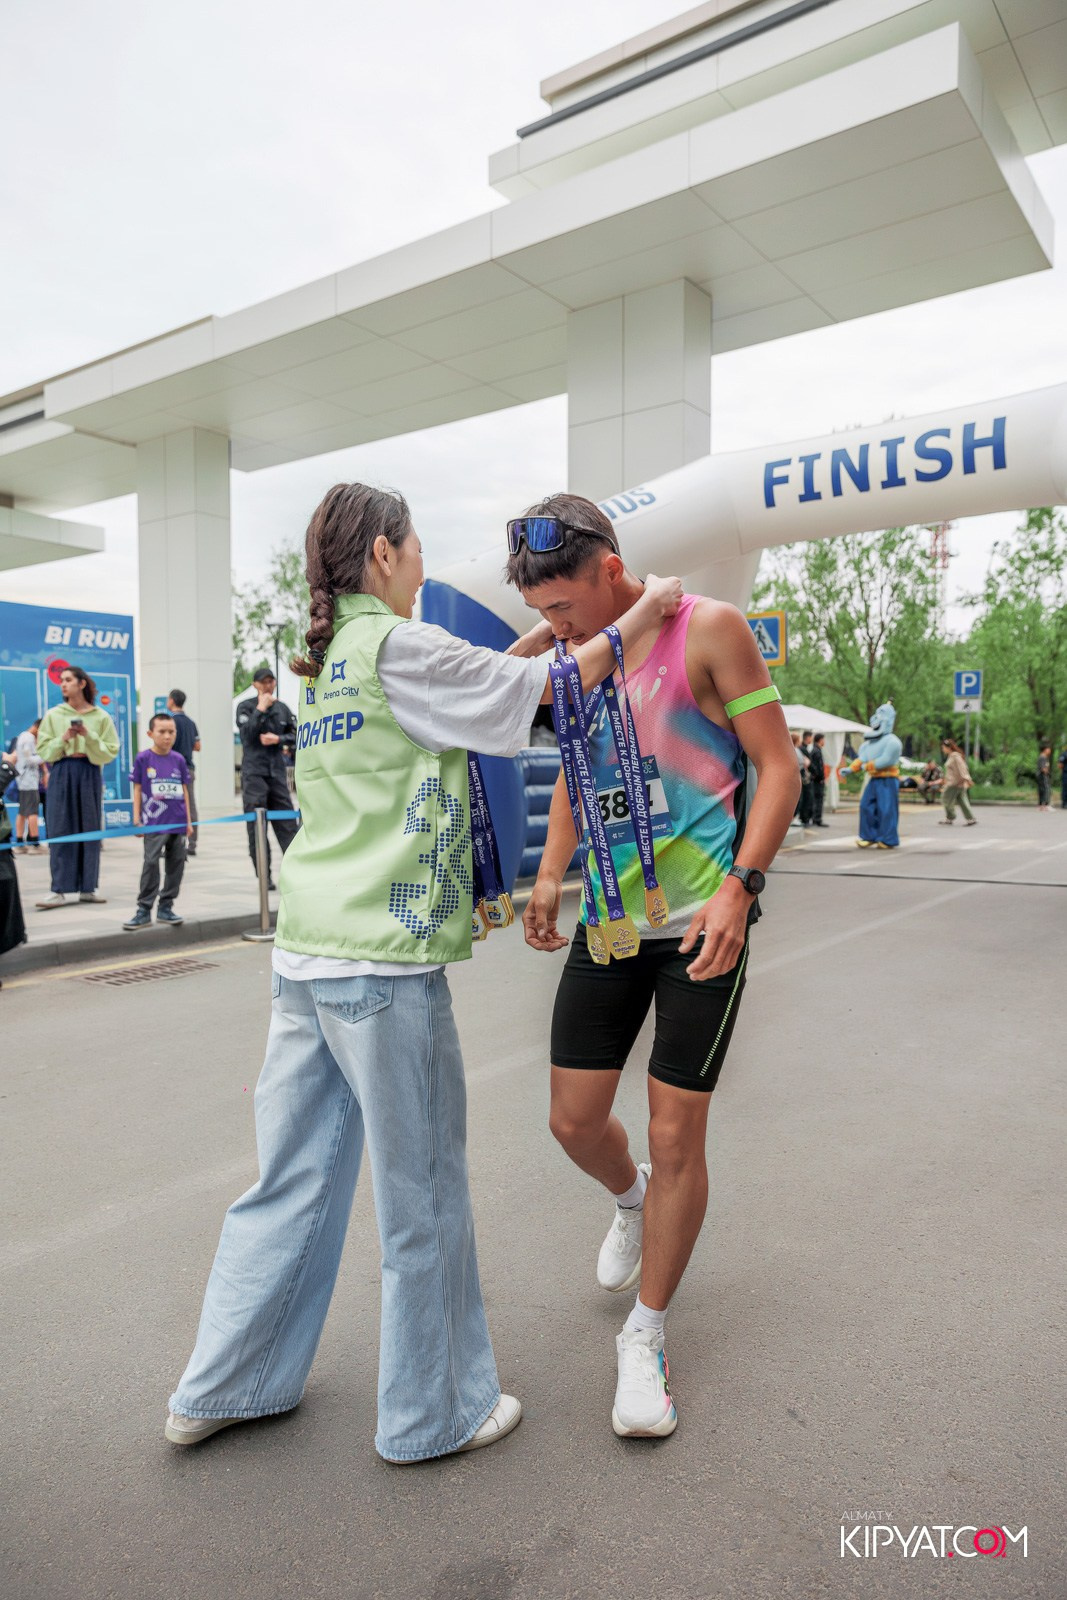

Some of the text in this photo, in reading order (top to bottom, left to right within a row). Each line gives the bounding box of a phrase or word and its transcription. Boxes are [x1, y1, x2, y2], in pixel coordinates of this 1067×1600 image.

[763, 416, 1007, 508] FINISH
[44, 625, 72, 646] BI
[78, 628, 130, 650] RUN
[323, 690, 340, 700] Arena
[341, 686, 360, 697] City
[572, 684, 582, 711] Dream
[961, 673, 978, 694] P
[556, 690, 568, 735] Dream City
[611, 710, 626, 748] ВМЕСТЕ
[469, 760, 482, 791] ВМЕСТЕ
[572, 739, 589, 777] ВМЕСТЕ
[633, 774, 648, 819] ДОБРЫМ
[639, 828, 652, 865] ВМЕСТЕ
[602, 860, 617, 897] ВМЕСТЕ
